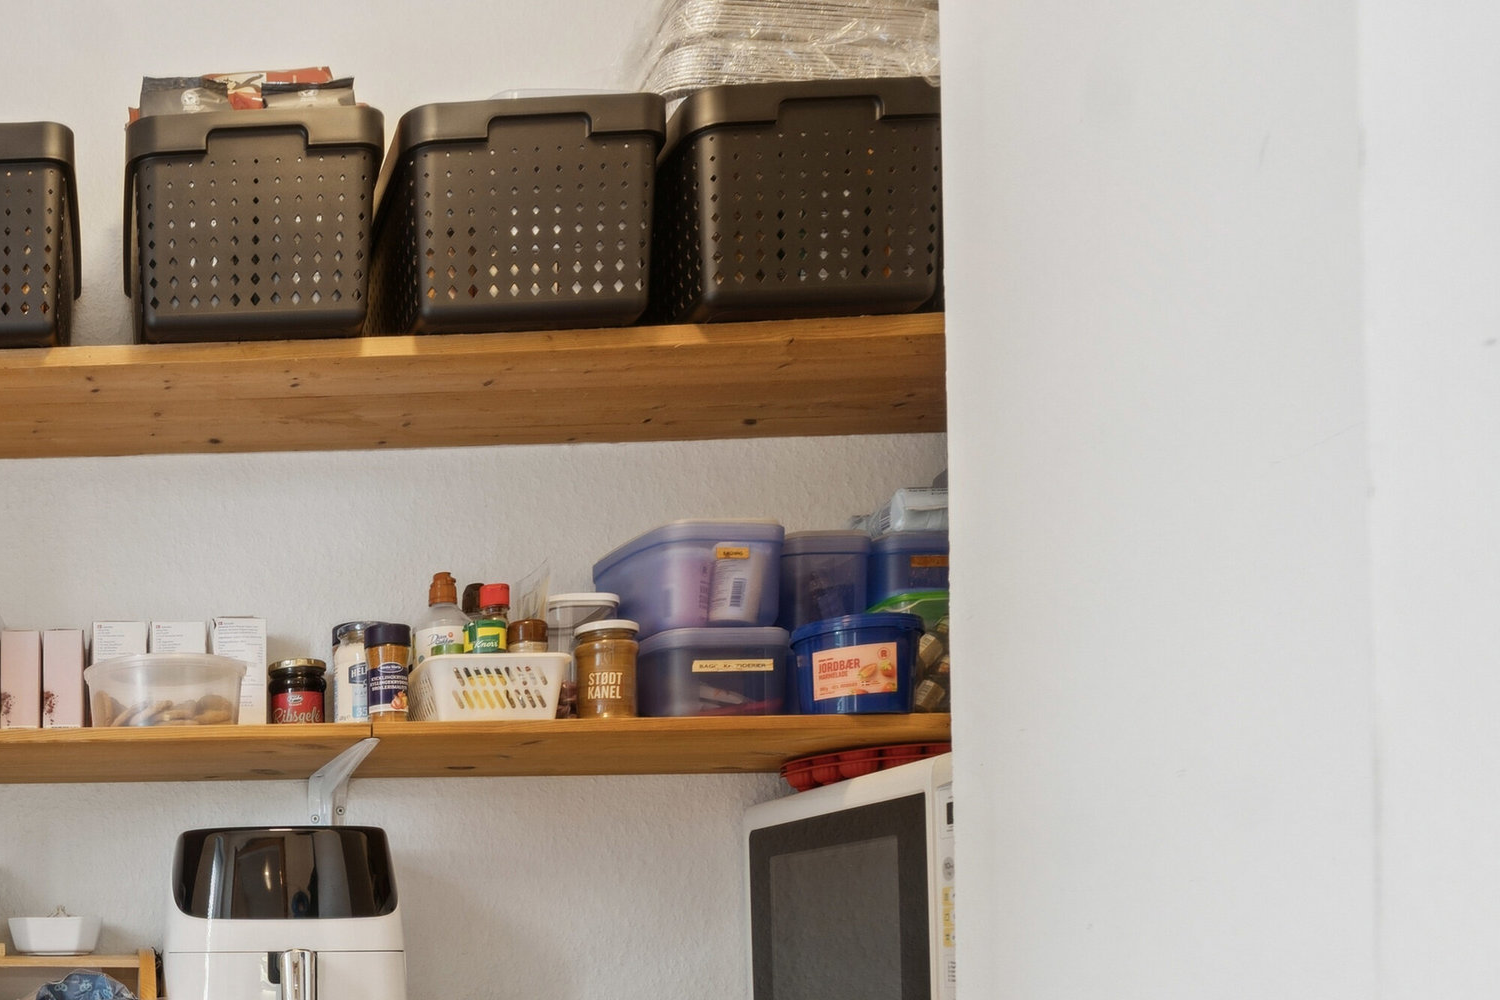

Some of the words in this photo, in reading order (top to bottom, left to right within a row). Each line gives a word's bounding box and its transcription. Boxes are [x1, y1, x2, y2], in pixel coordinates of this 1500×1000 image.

[474, 640, 499, 648] Knorr
[818, 658, 860, 674] JORDBÆR
[588, 672, 623, 686] STØDT
[587, 685, 622, 700] KANEL
